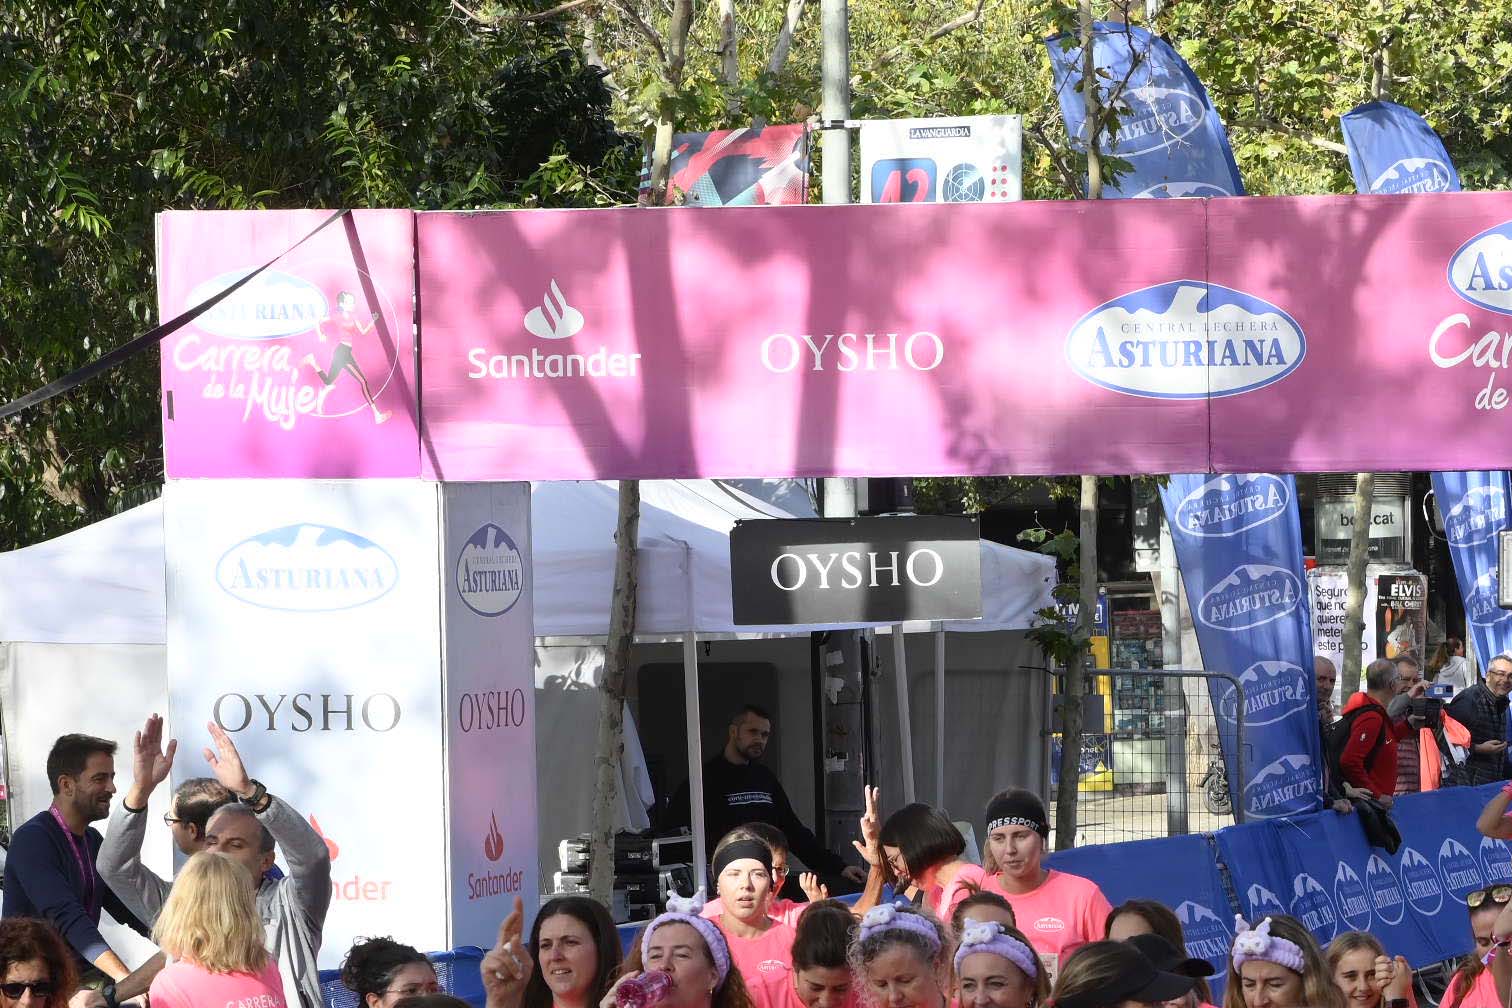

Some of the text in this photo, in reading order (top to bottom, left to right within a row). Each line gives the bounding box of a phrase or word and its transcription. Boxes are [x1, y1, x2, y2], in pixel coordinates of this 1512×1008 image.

[1204, 320, 1280, 333] LECHERA
[173, 335, 292, 372] Carrera
[468, 347, 642, 379] Santander
[761, 332, 944, 373] OYSHO
[1089, 326, 1288, 368] ASTURIANA
[203, 367, 336, 431] de la Mujer
[1474, 372, 1508, 410] de
[231, 557, 385, 590] ASTURIANA
[462, 558, 521, 594] ASTURIANA
[771, 548, 944, 591] OYSHO
[1391, 584, 1422, 597] ELVIS
[213, 693, 402, 733] OYSHO
[459, 688, 526, 734] OYSHO
[469, 867, 524, 901] Santander
